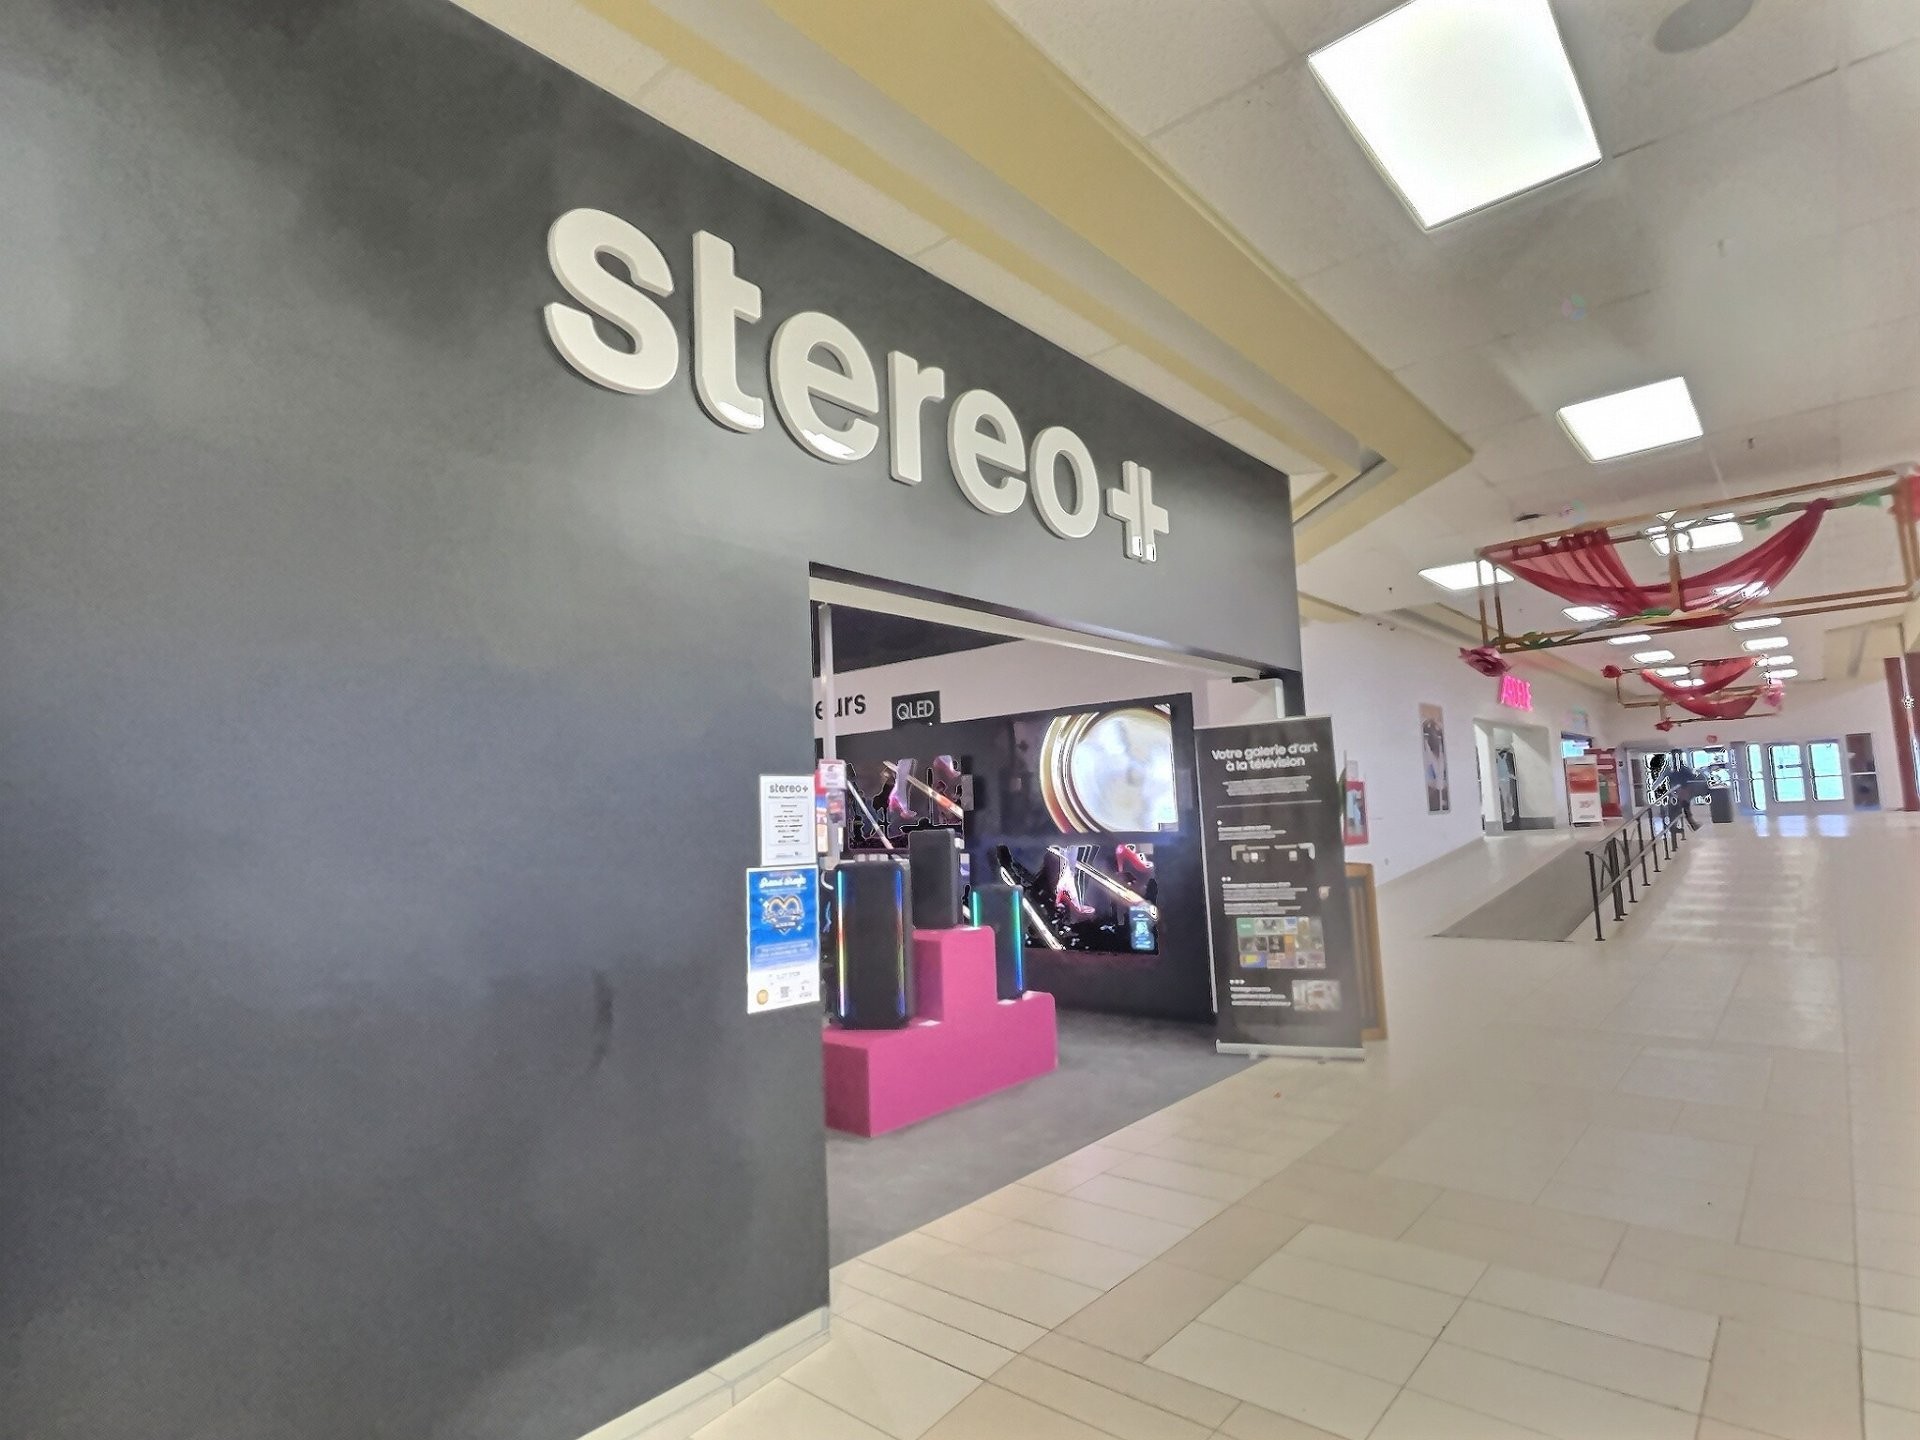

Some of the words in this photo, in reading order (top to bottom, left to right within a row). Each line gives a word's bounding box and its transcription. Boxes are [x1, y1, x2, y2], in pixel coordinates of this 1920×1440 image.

[544, 207, 1169, 563] stereo+
[896, 700, 935, 720] QLED
[1211, 749, 1243, 760] Votre
[1244, 744, 1286, 760] galerie
[1288, 742, 1318, 754] d'art
[1225, 760, 1235, 772] à
[1236, 759, 1248, 771] la
[1249, 756, 1306, 770] télévision
[769, 783, 808, 793] stereo+
